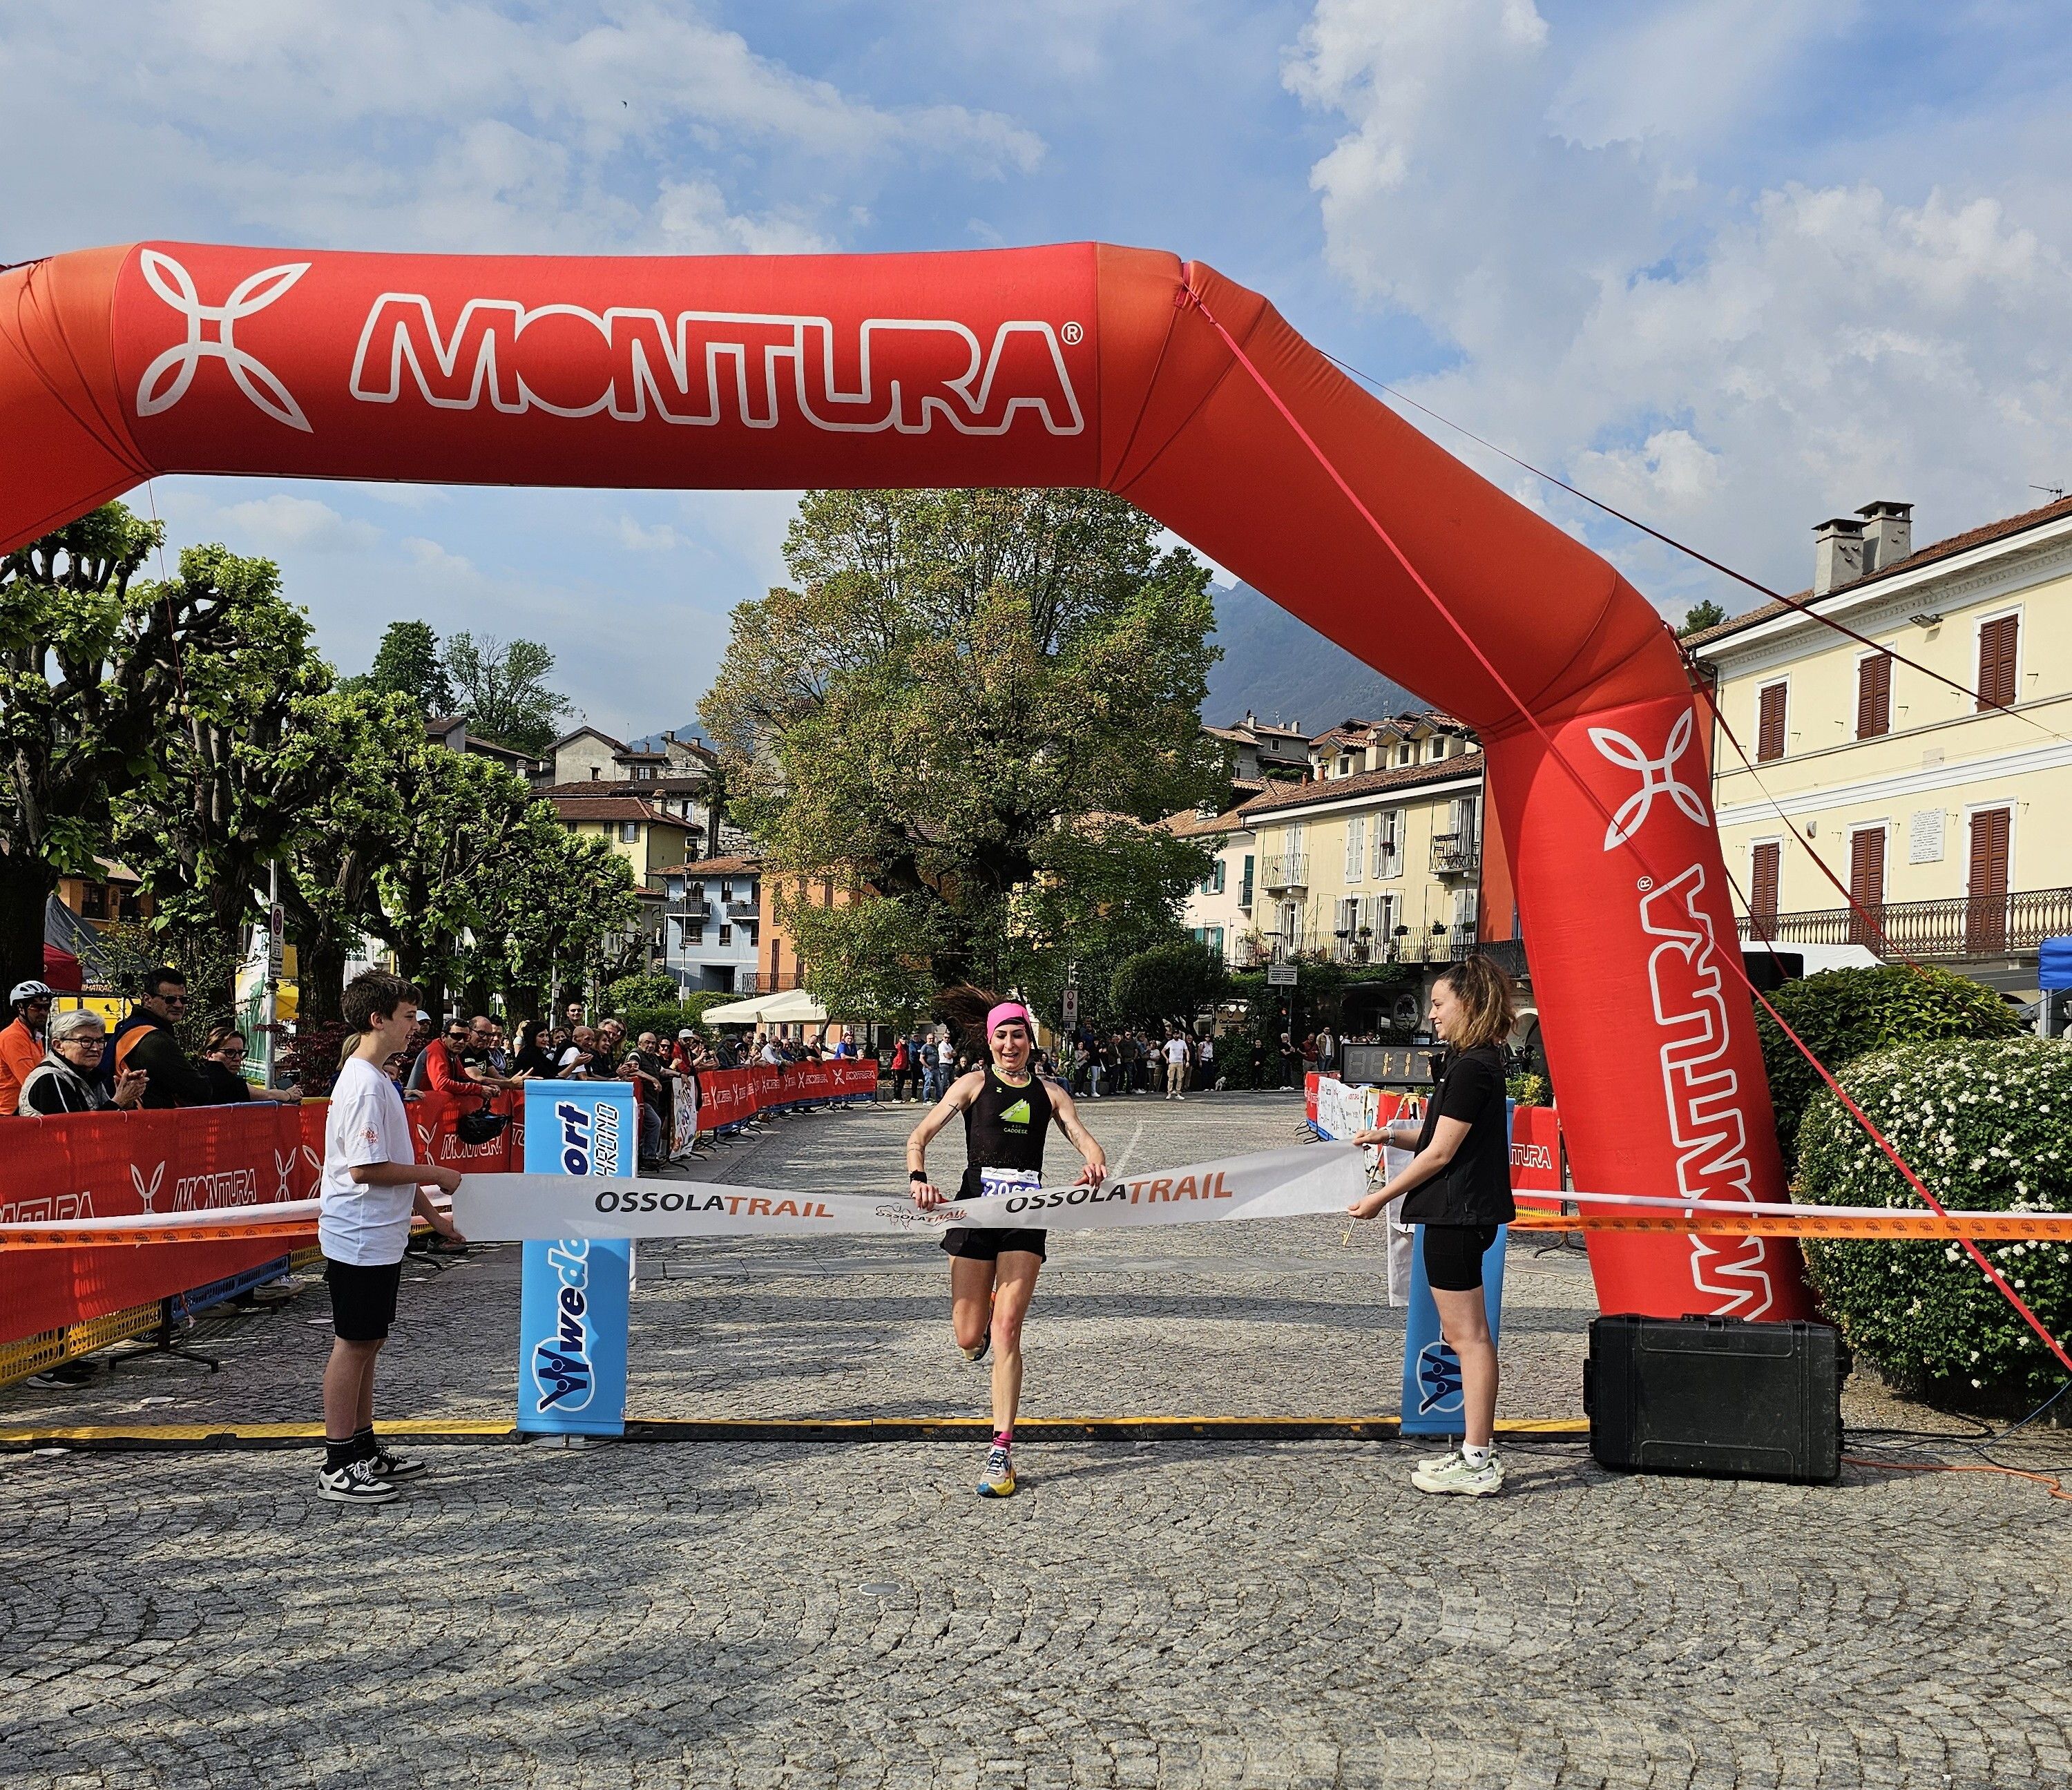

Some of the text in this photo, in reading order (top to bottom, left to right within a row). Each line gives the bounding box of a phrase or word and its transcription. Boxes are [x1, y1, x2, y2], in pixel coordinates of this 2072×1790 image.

[593, 1102, 620, 1177] HRONO
[1510, 1143, 1553, 1170] TURA
[595, 1191, 834, 1218] OSSOLATRAIL
[1005, 1171, 1233, 1213] OSSOLATRAIL
